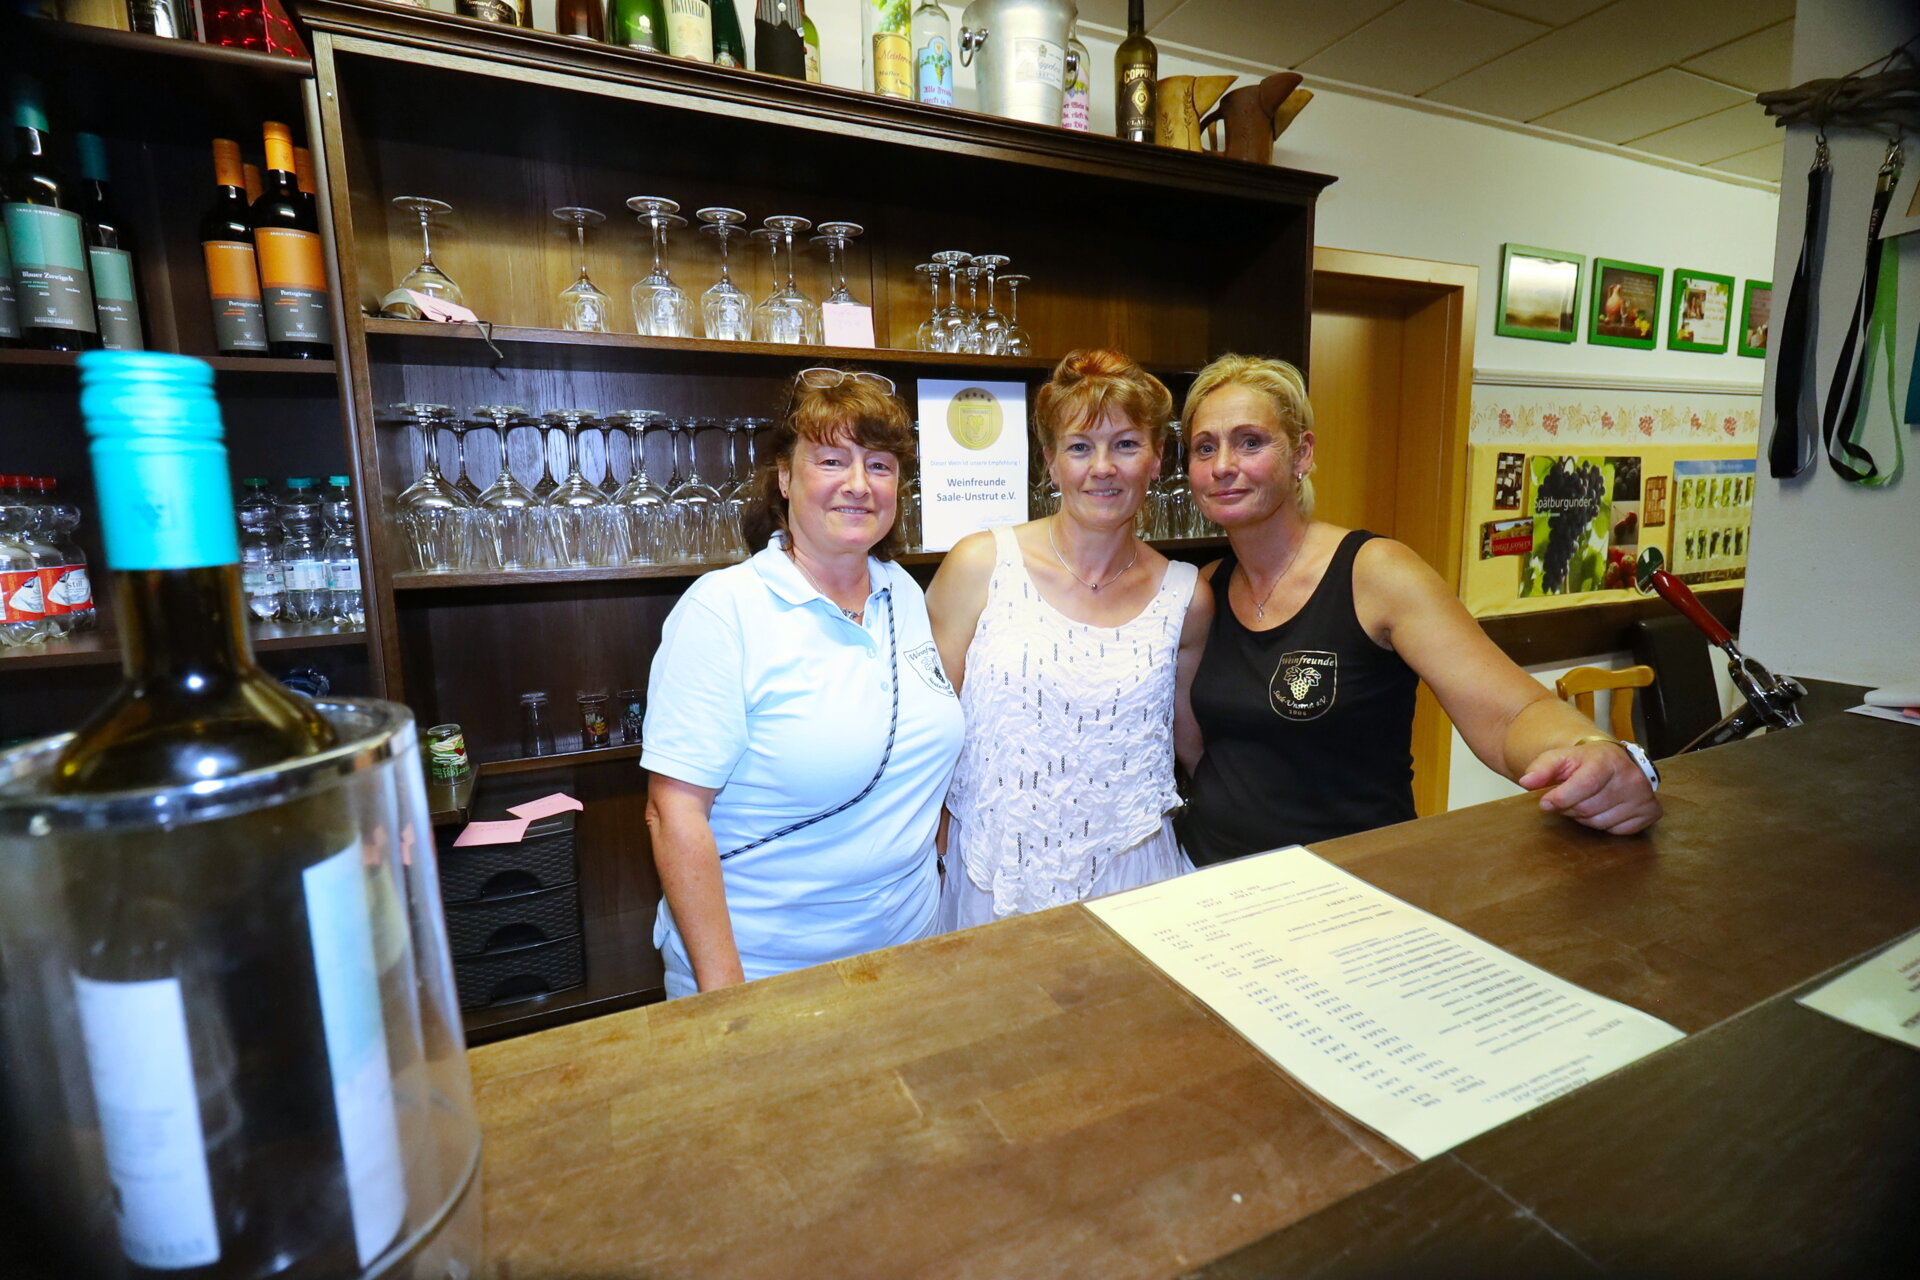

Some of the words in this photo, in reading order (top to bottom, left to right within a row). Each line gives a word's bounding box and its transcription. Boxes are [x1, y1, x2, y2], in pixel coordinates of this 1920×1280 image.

[947, 477, 1006, 488] Weinfreunde
[937, 491, 1000, 502] Saale-Unstrut
[1001, 491, 1017, 501] e.V.
[1534, 495, 1592, 511] Spätburgunder
